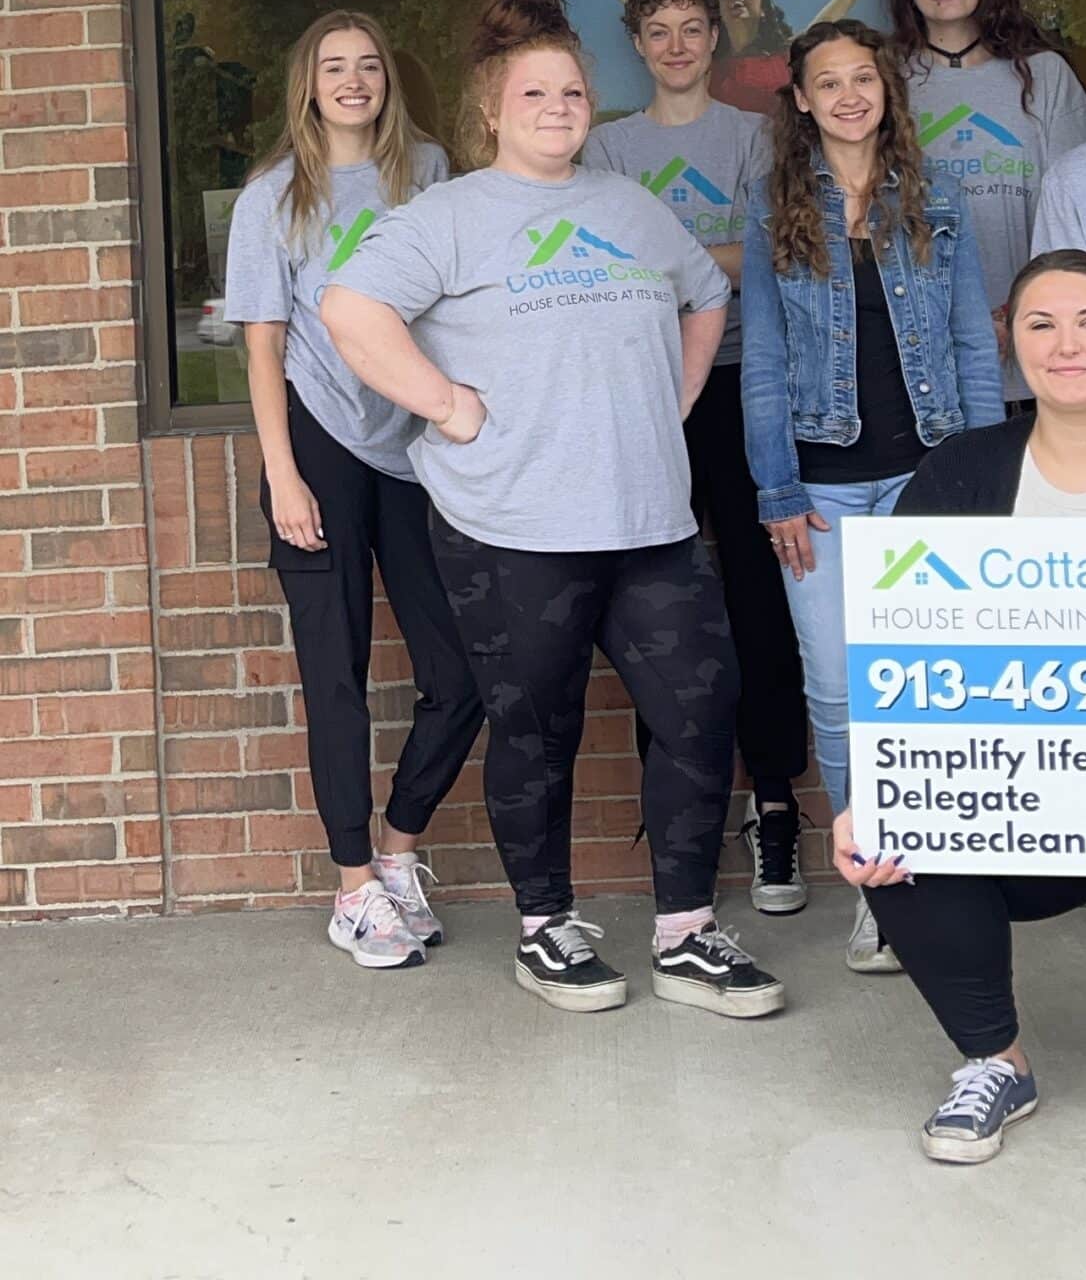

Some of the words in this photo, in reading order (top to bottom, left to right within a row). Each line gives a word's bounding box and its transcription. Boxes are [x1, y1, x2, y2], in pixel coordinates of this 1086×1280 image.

[926, 151, 1034, 179] tageCare
[509, 298, 553, 317] HOUSE
[557, 291, 617, 307] CLEANING
[621, 290, 633, 301] AT
[637, 289, 651, 300] ITS
[872, 608, 965, 630] HOUSE
[875, 738, 1026, 779] Simplify
[875, 778, 1041, 820] Delegate
